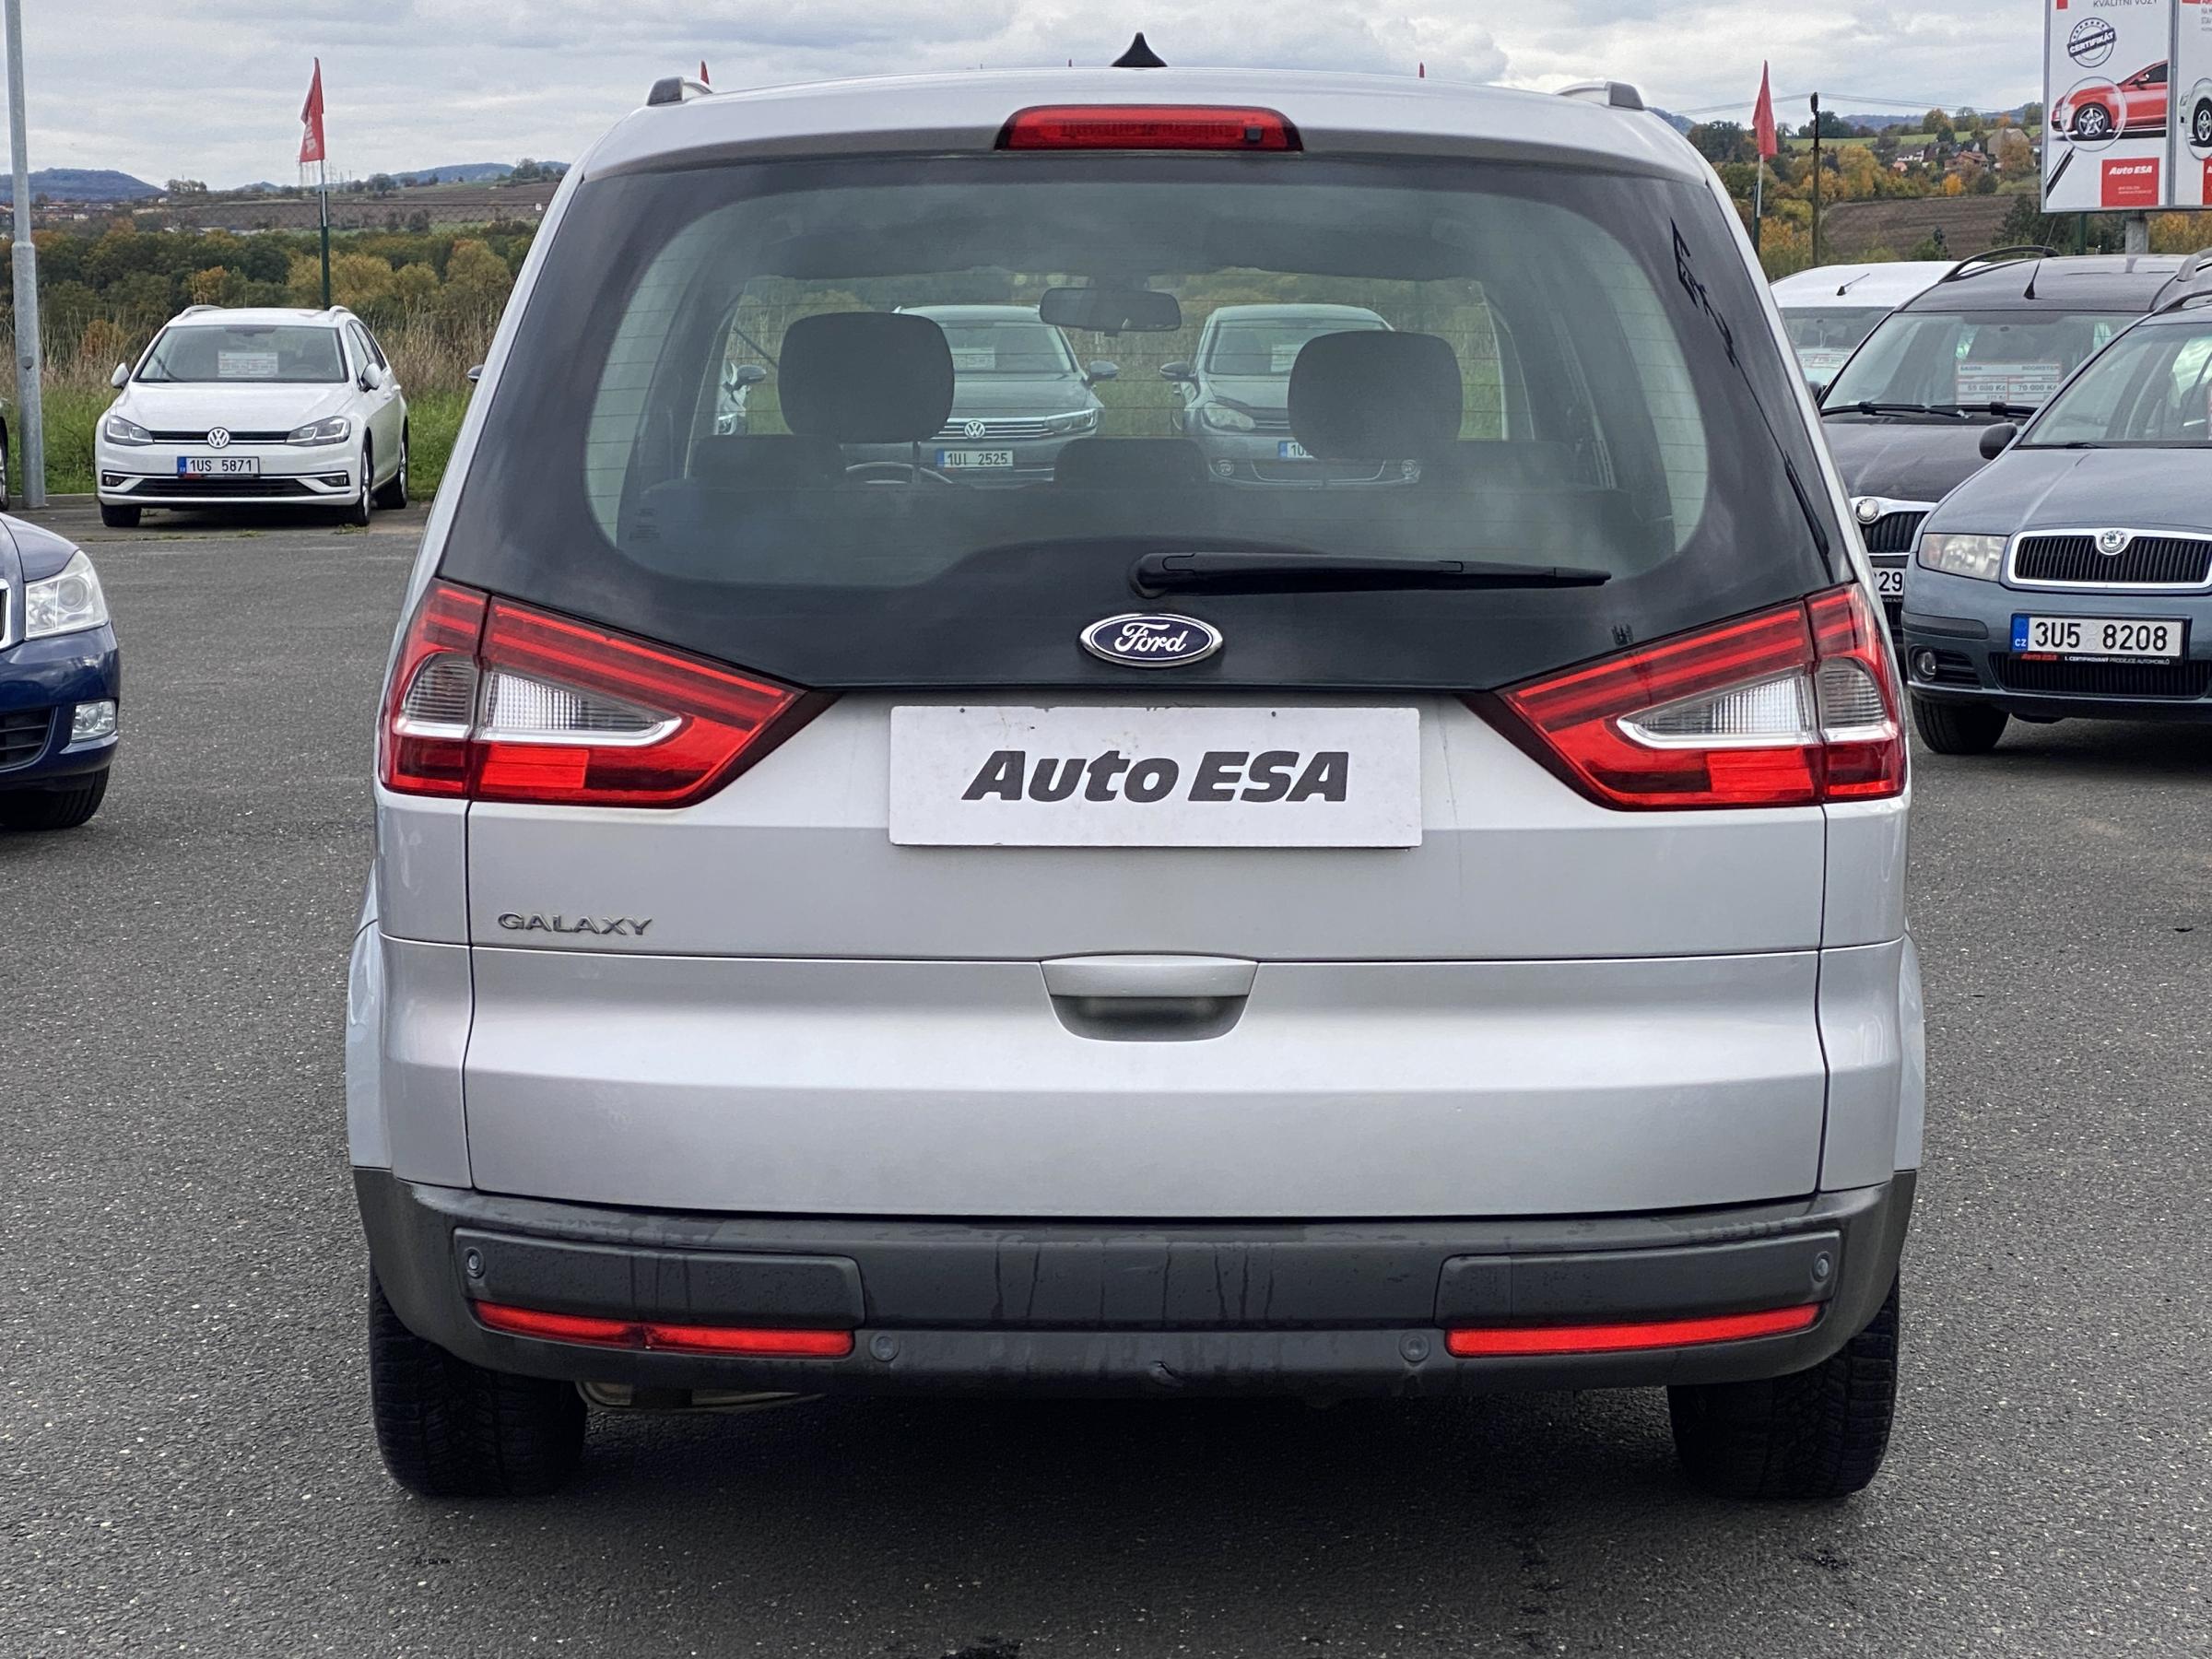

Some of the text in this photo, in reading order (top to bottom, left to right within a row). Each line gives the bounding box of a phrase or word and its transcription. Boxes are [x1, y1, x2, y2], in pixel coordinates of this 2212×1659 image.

[2109, 166, 2153, 175] Auto ESA
[978, 453, 1007, 465] 2525
[1290, 444, 1306, 457] 1U
[190, 460, 212, 472] 1US
[221, 460, 252, 472] 5871
[1874, 571, 1903, 592] 29
[1114, 622, 1189, 652] Ford
[2015, 638, 2027, 647] CZ
[2035, 621, 2168, 652] 3U5 8208
[960, 749, 1350, 803] Auto ESA
[497, 911, 653, 936] GALAXY
